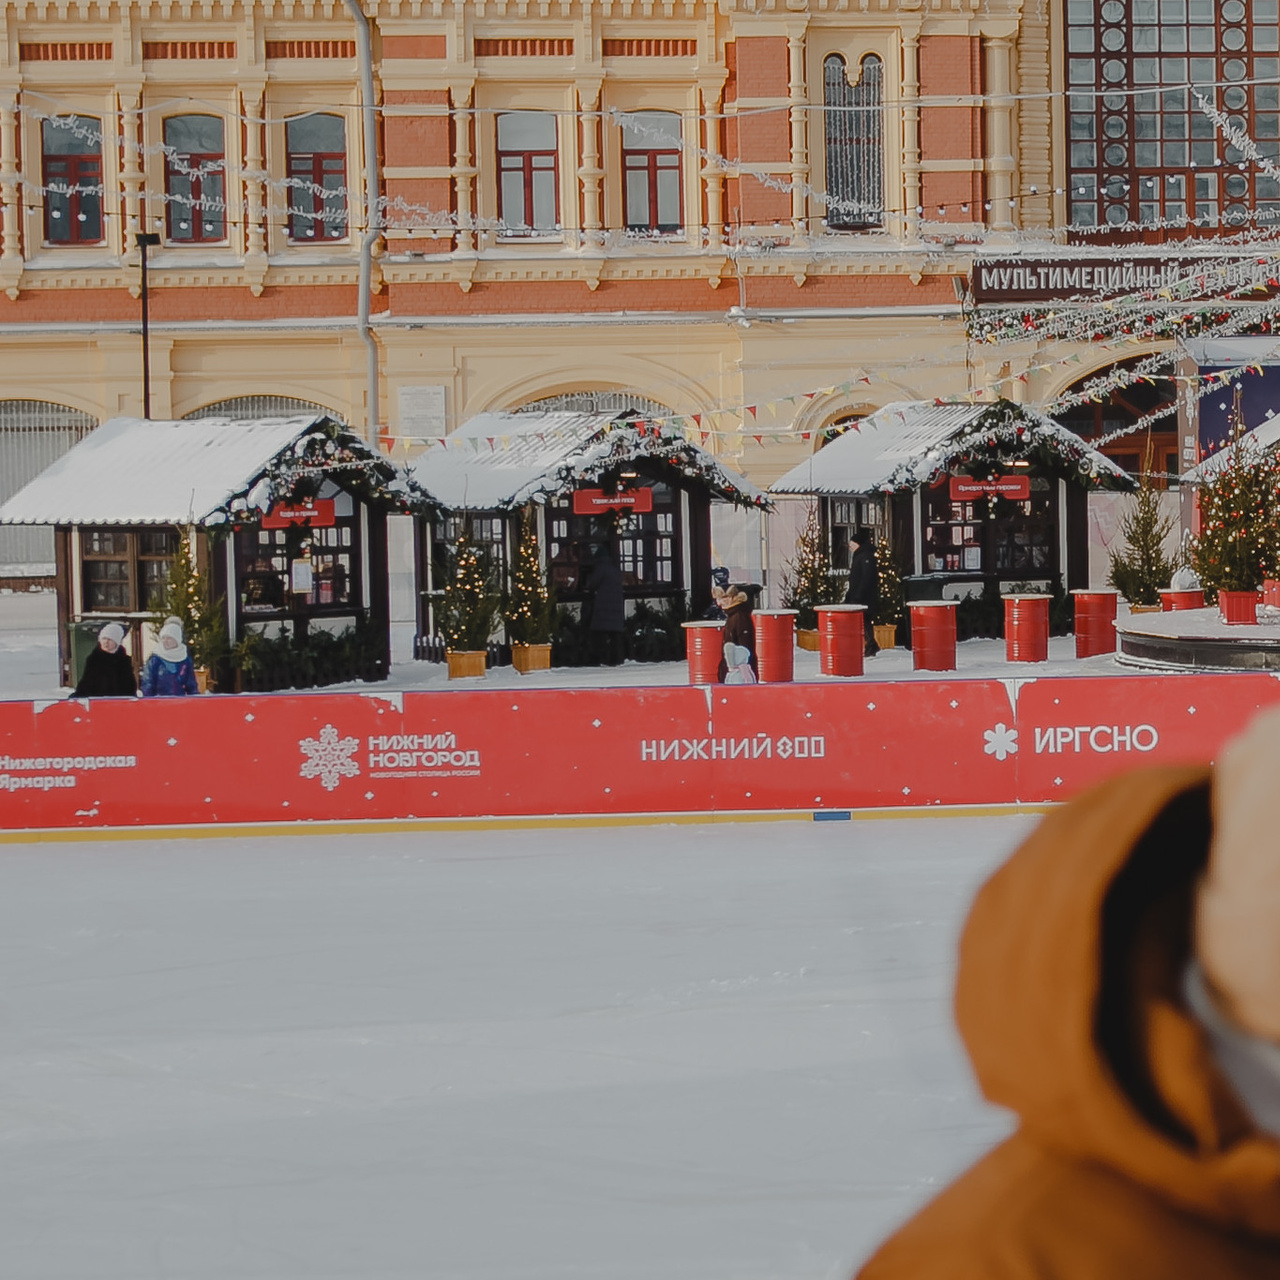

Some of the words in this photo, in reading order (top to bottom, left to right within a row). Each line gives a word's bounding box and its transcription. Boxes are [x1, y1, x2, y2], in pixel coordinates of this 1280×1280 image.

[981, 261, 1180, 290] МУЛЬТИМЕДИЙНЫЙ
[368, 731, 456, 751] НИЖНИЙ
[641, 732, 772, 761] НИЖНИЙ
[1034, 723, 1160, 754] ИРГСНО
[0, 755, 137, 772] Нижегородская
[368, 750, 480, 768] НОВГОРОД
[0, 774, 77, 792] Ярмарка
